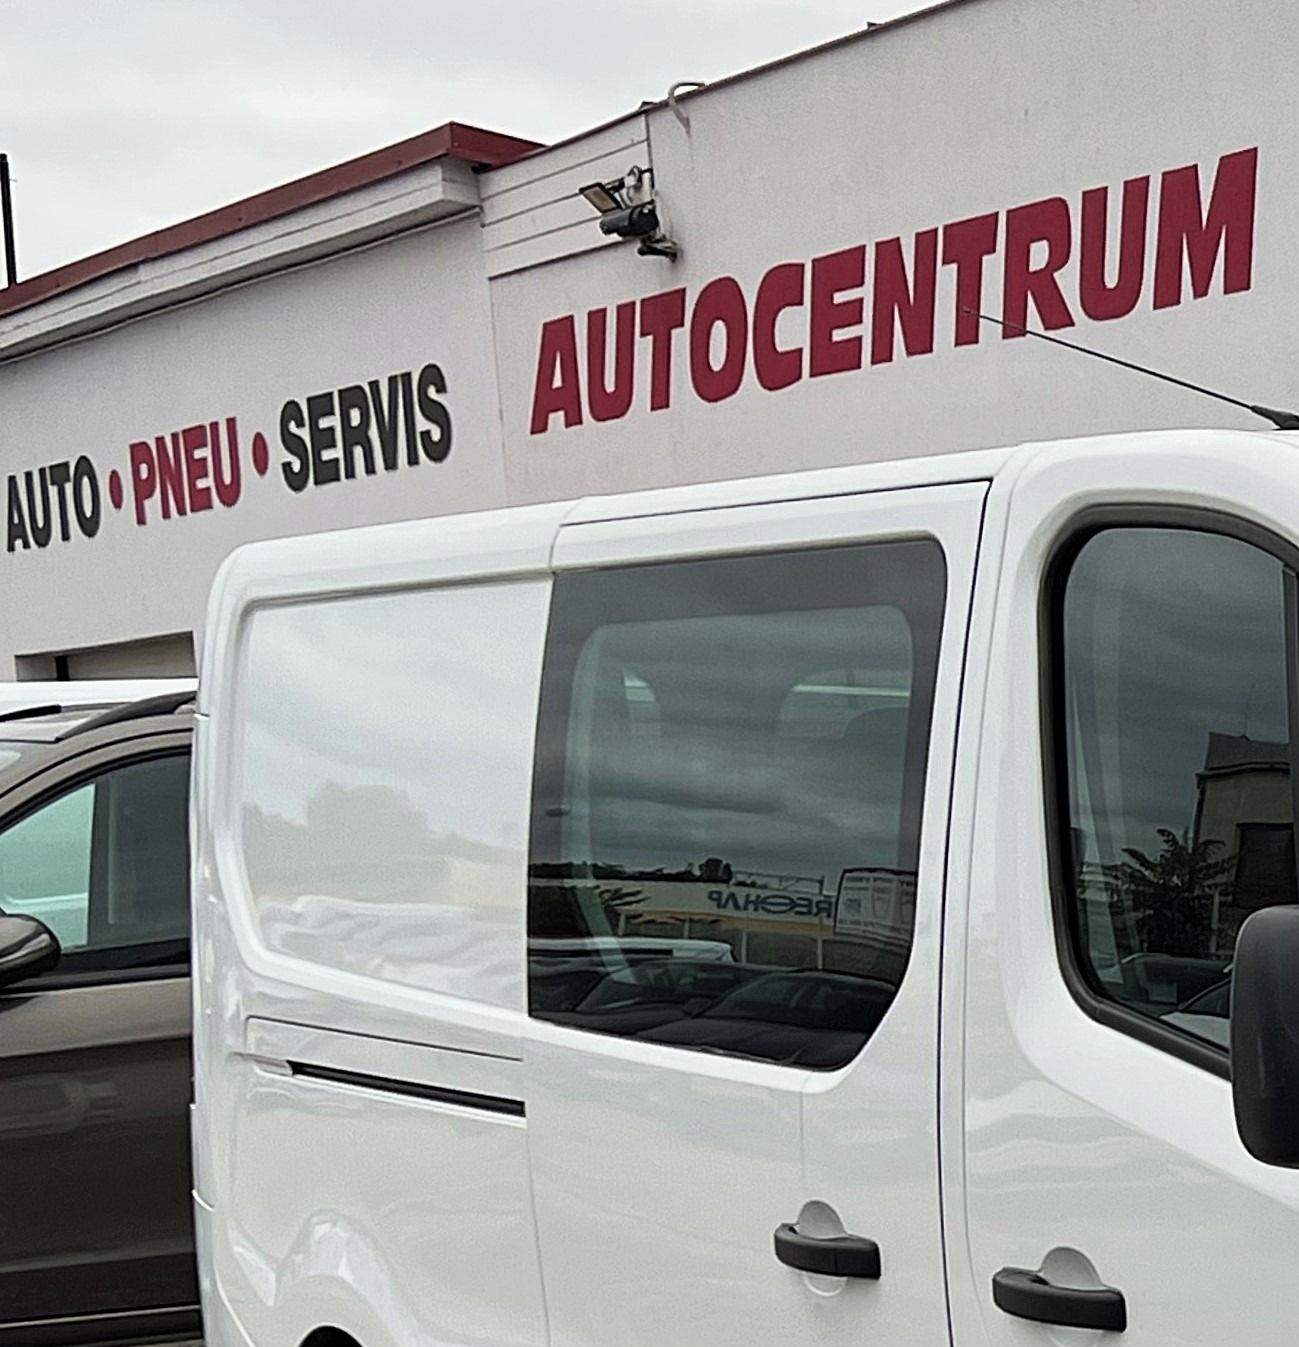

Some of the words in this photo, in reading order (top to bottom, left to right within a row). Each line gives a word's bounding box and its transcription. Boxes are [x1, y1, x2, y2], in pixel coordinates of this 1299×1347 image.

[530, 147, 1258, 434] AUTOCENTRUM
[6, 455, 100, 553] AUTO
[129, 417, 242, 526] PNEU
[280, 363, 452, 493] SERVIS
